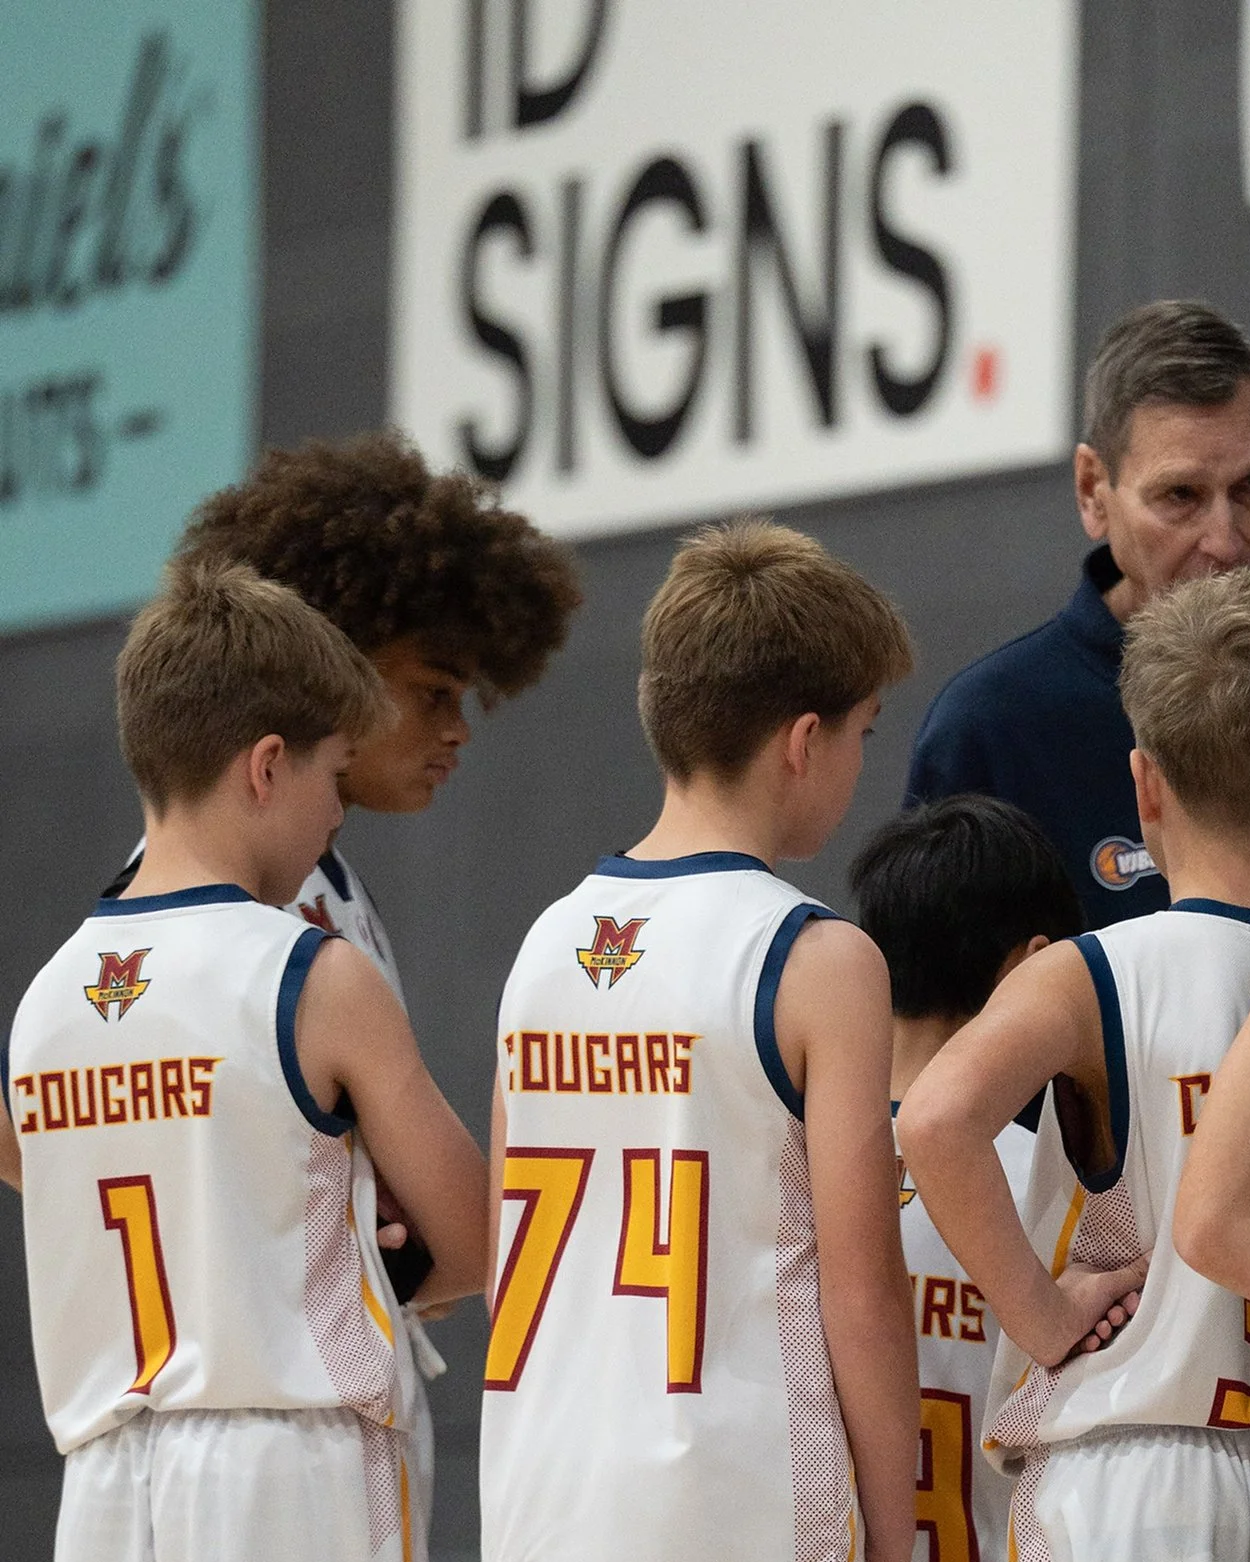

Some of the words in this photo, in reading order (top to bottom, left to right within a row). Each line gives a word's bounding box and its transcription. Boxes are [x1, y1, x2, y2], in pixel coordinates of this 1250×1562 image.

[13, 1055, 226, 1135] COUGARS
[97, 1174, 177, 1396] 1
[484, 1147, 710, 1394] 74
